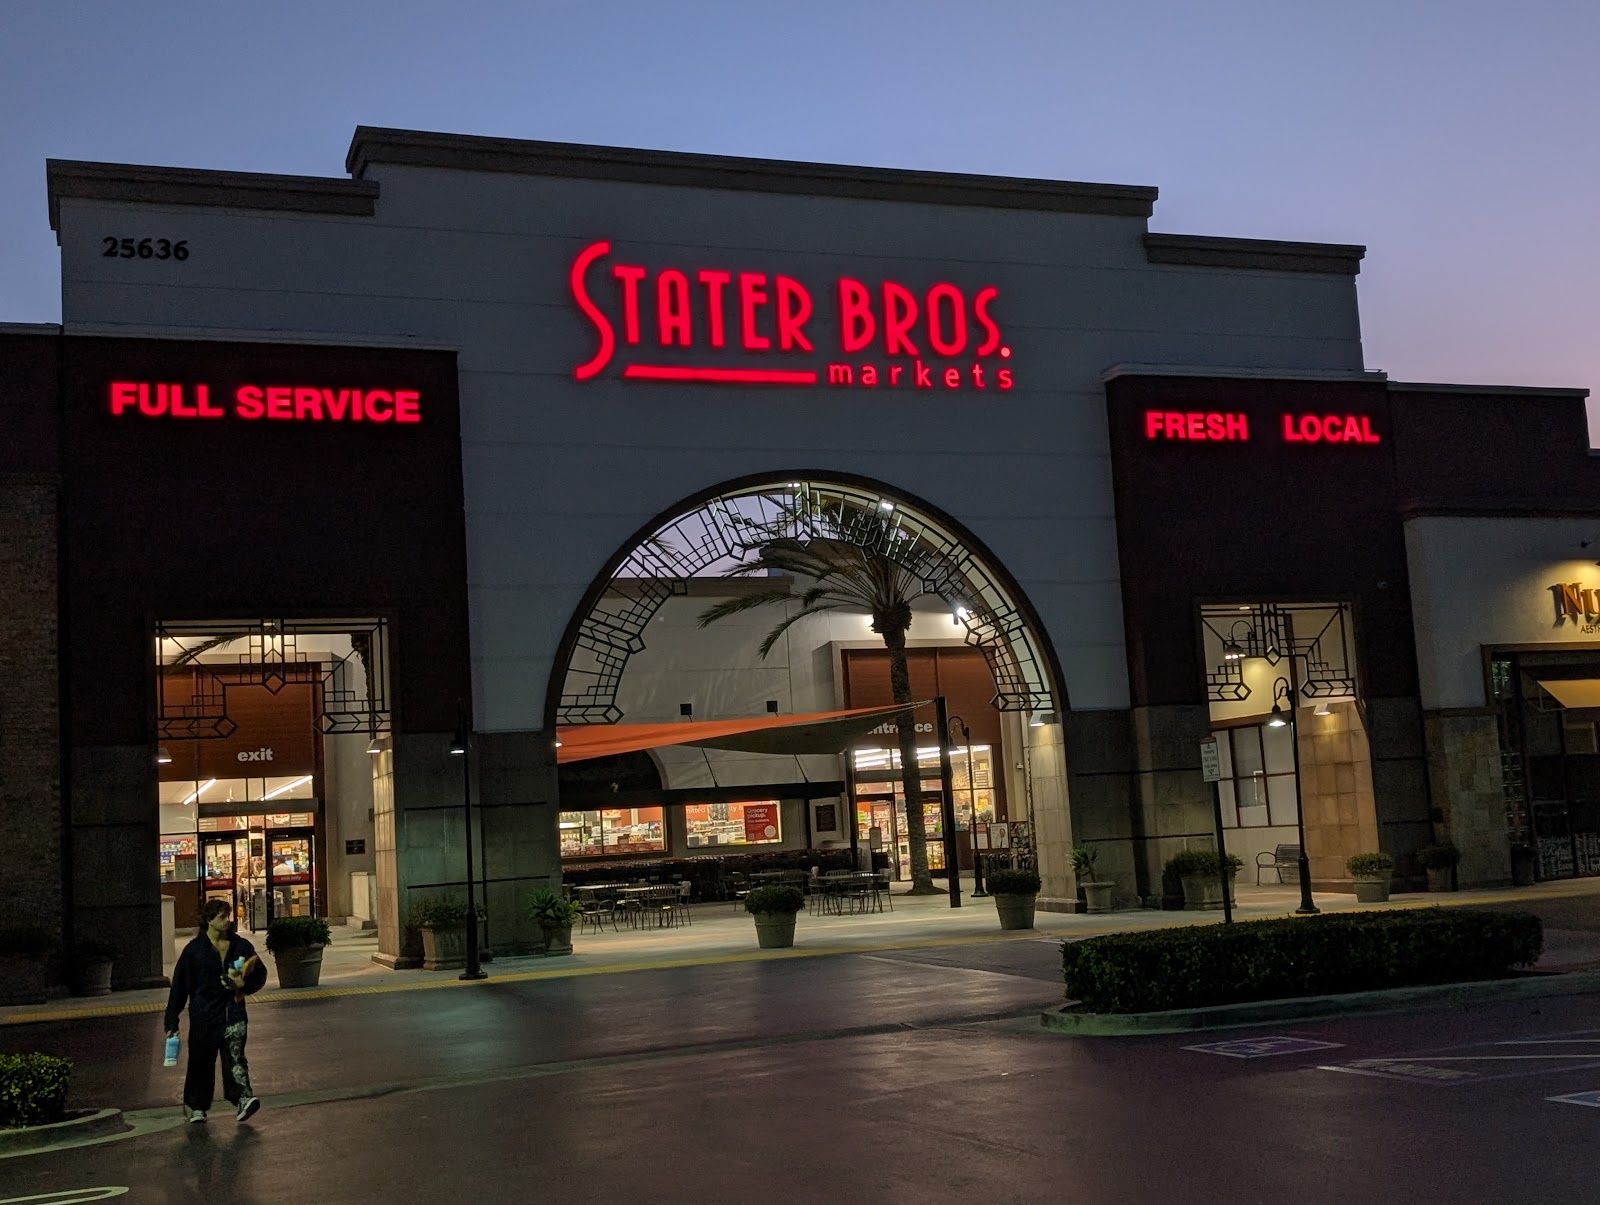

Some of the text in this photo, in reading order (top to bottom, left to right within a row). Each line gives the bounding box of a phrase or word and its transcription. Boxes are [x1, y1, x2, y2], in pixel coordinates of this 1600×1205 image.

[102, 236, 189, 261] 25636
[569, 241, 1012, 380] STATER BROS.
[827, 360, 1014, 391] markets
[109, 381, 422, 424] FULL SERVICE
[1145, 411, 1380, 444] FRESH LOCAL
[867, 723, 933, 735] ntrce
[237, 747, 273, 761] exit
